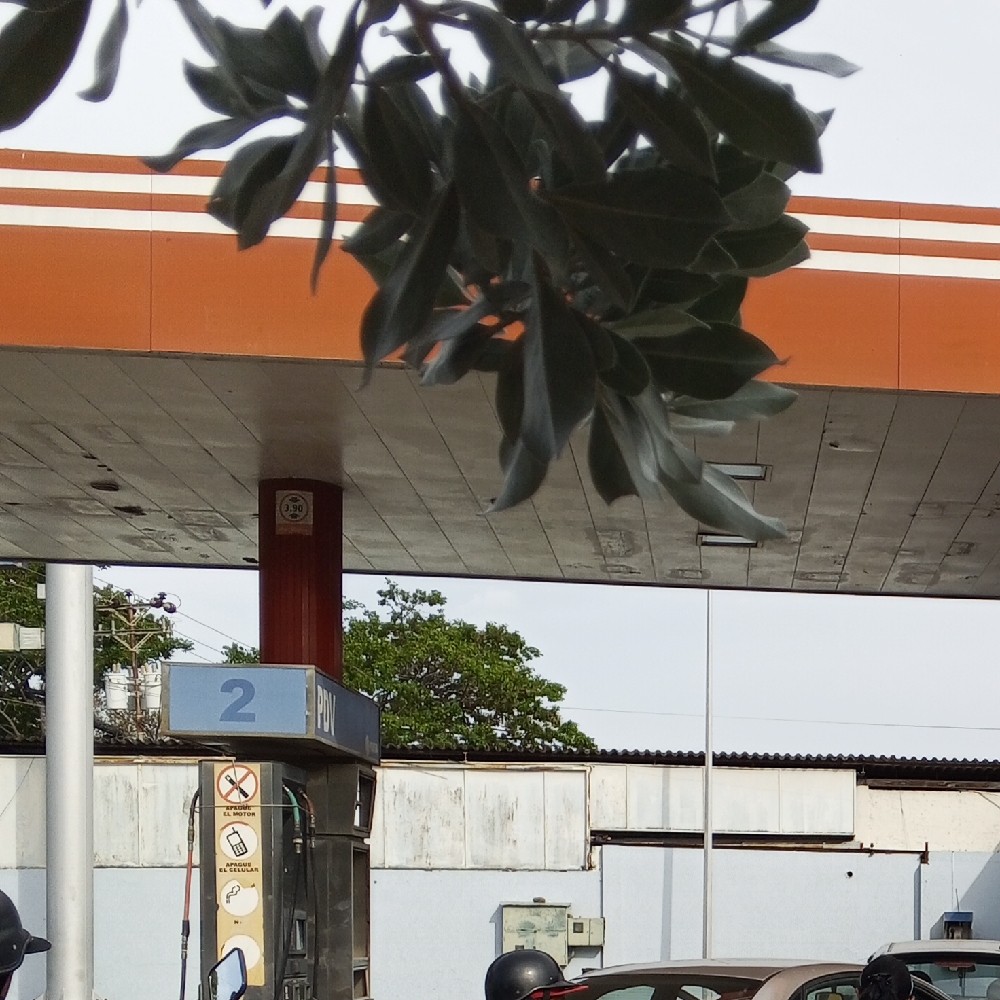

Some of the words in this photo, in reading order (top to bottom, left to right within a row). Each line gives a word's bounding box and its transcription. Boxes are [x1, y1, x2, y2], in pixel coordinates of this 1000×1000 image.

[283, 503, 303, 513] 3.90
[219, 678, 256, 722] 2
[316, 684, 336, 736] PDV
